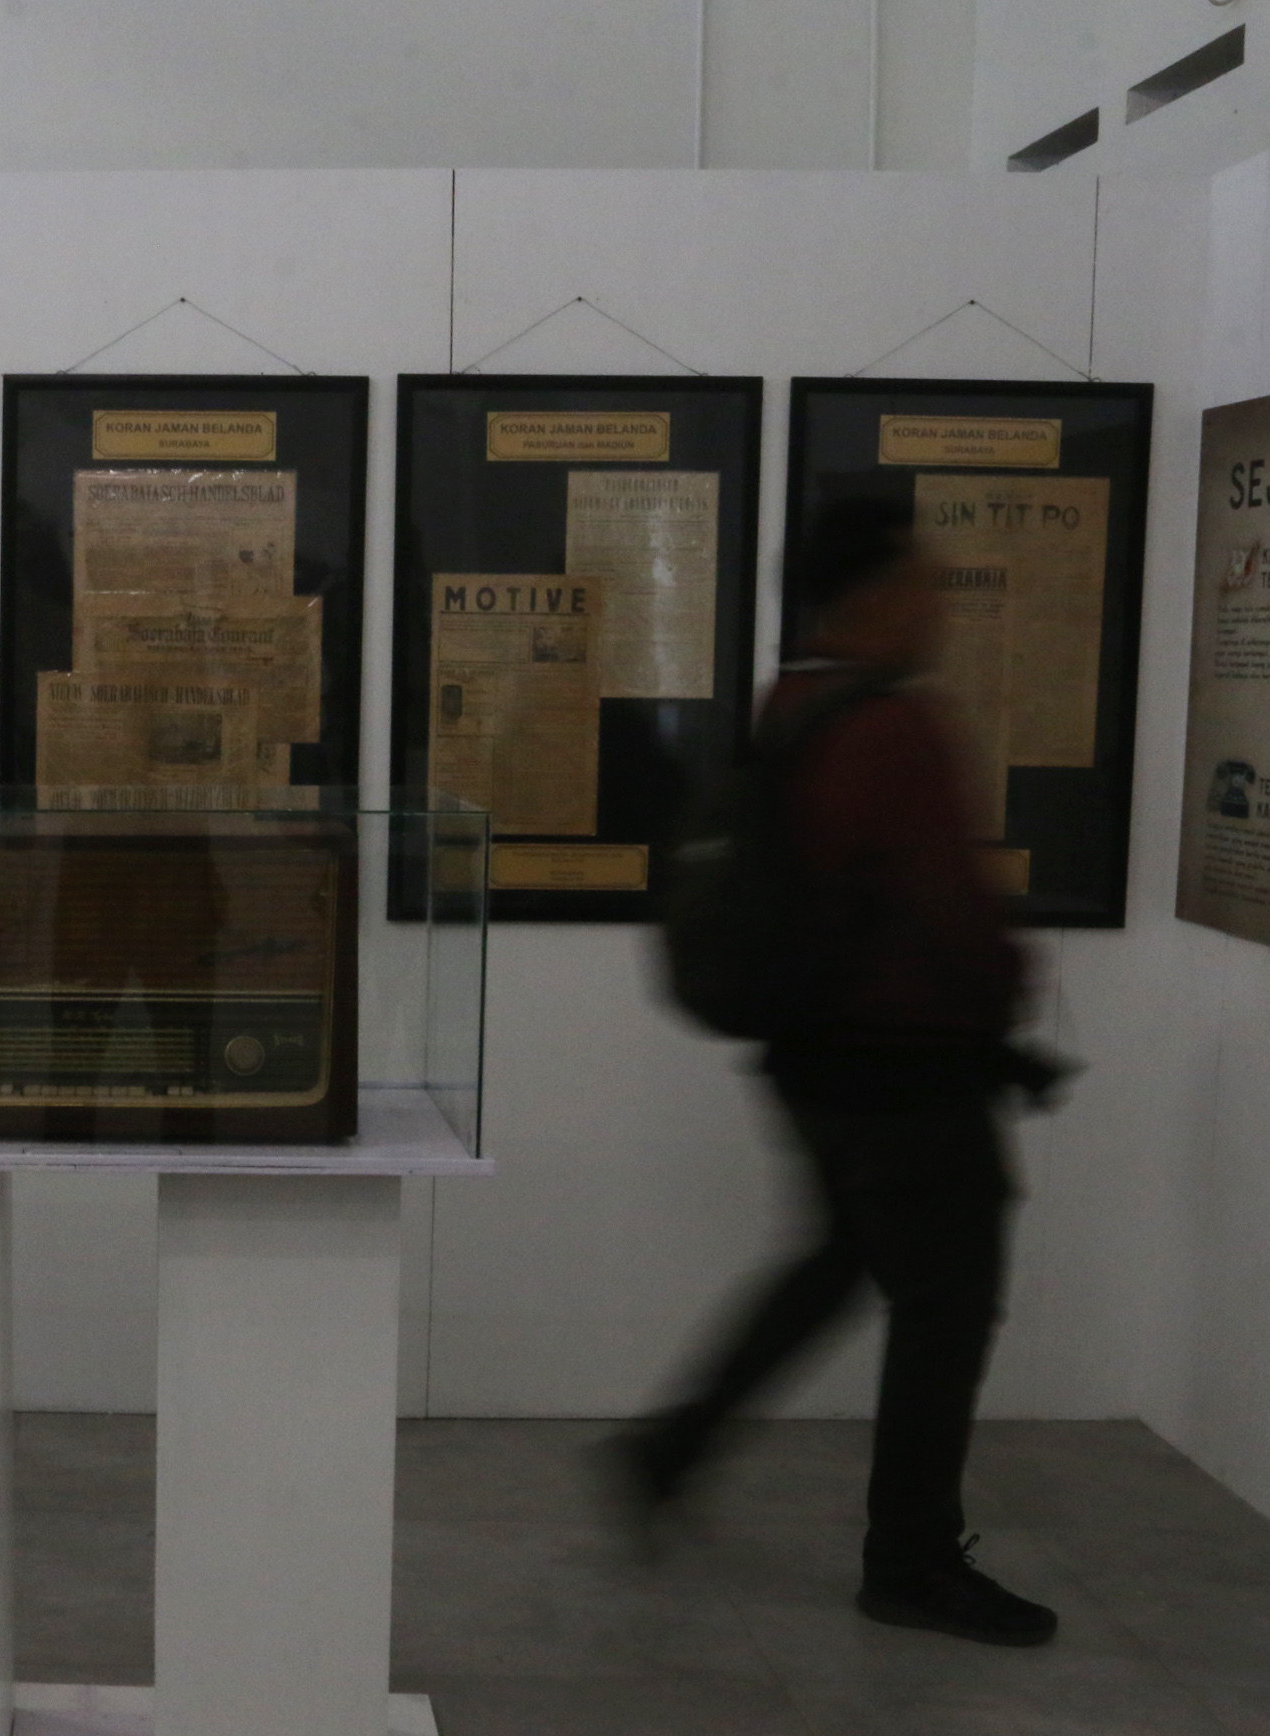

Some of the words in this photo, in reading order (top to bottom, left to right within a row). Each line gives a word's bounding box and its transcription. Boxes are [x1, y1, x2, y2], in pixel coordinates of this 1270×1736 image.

[106, 423, 151, 433] KORAN
[155, 423, 199, 433] JAMAN
[202, 423, 262, 434] BELANDA
[500, 424, 546, 434] KORAN
[549, 424, 595, 434] JAMAN
[597, 424, 657, 434] BELANDA
[892, 427, 937, 438] KORAN
[941, 428, 984, 439] JAMAN
[988, 429, 1048, 441] BELANDA
[159, 439, 210, 448] SURABAYA
[944, 446, 995, 454] SURABAYA
[1230, 459, 1270, 510] SE
[935, 502, 976, 527] SIN
[1041, 505, 1080, 530] PO
[444, 586, 586, 612] MOTIVE
